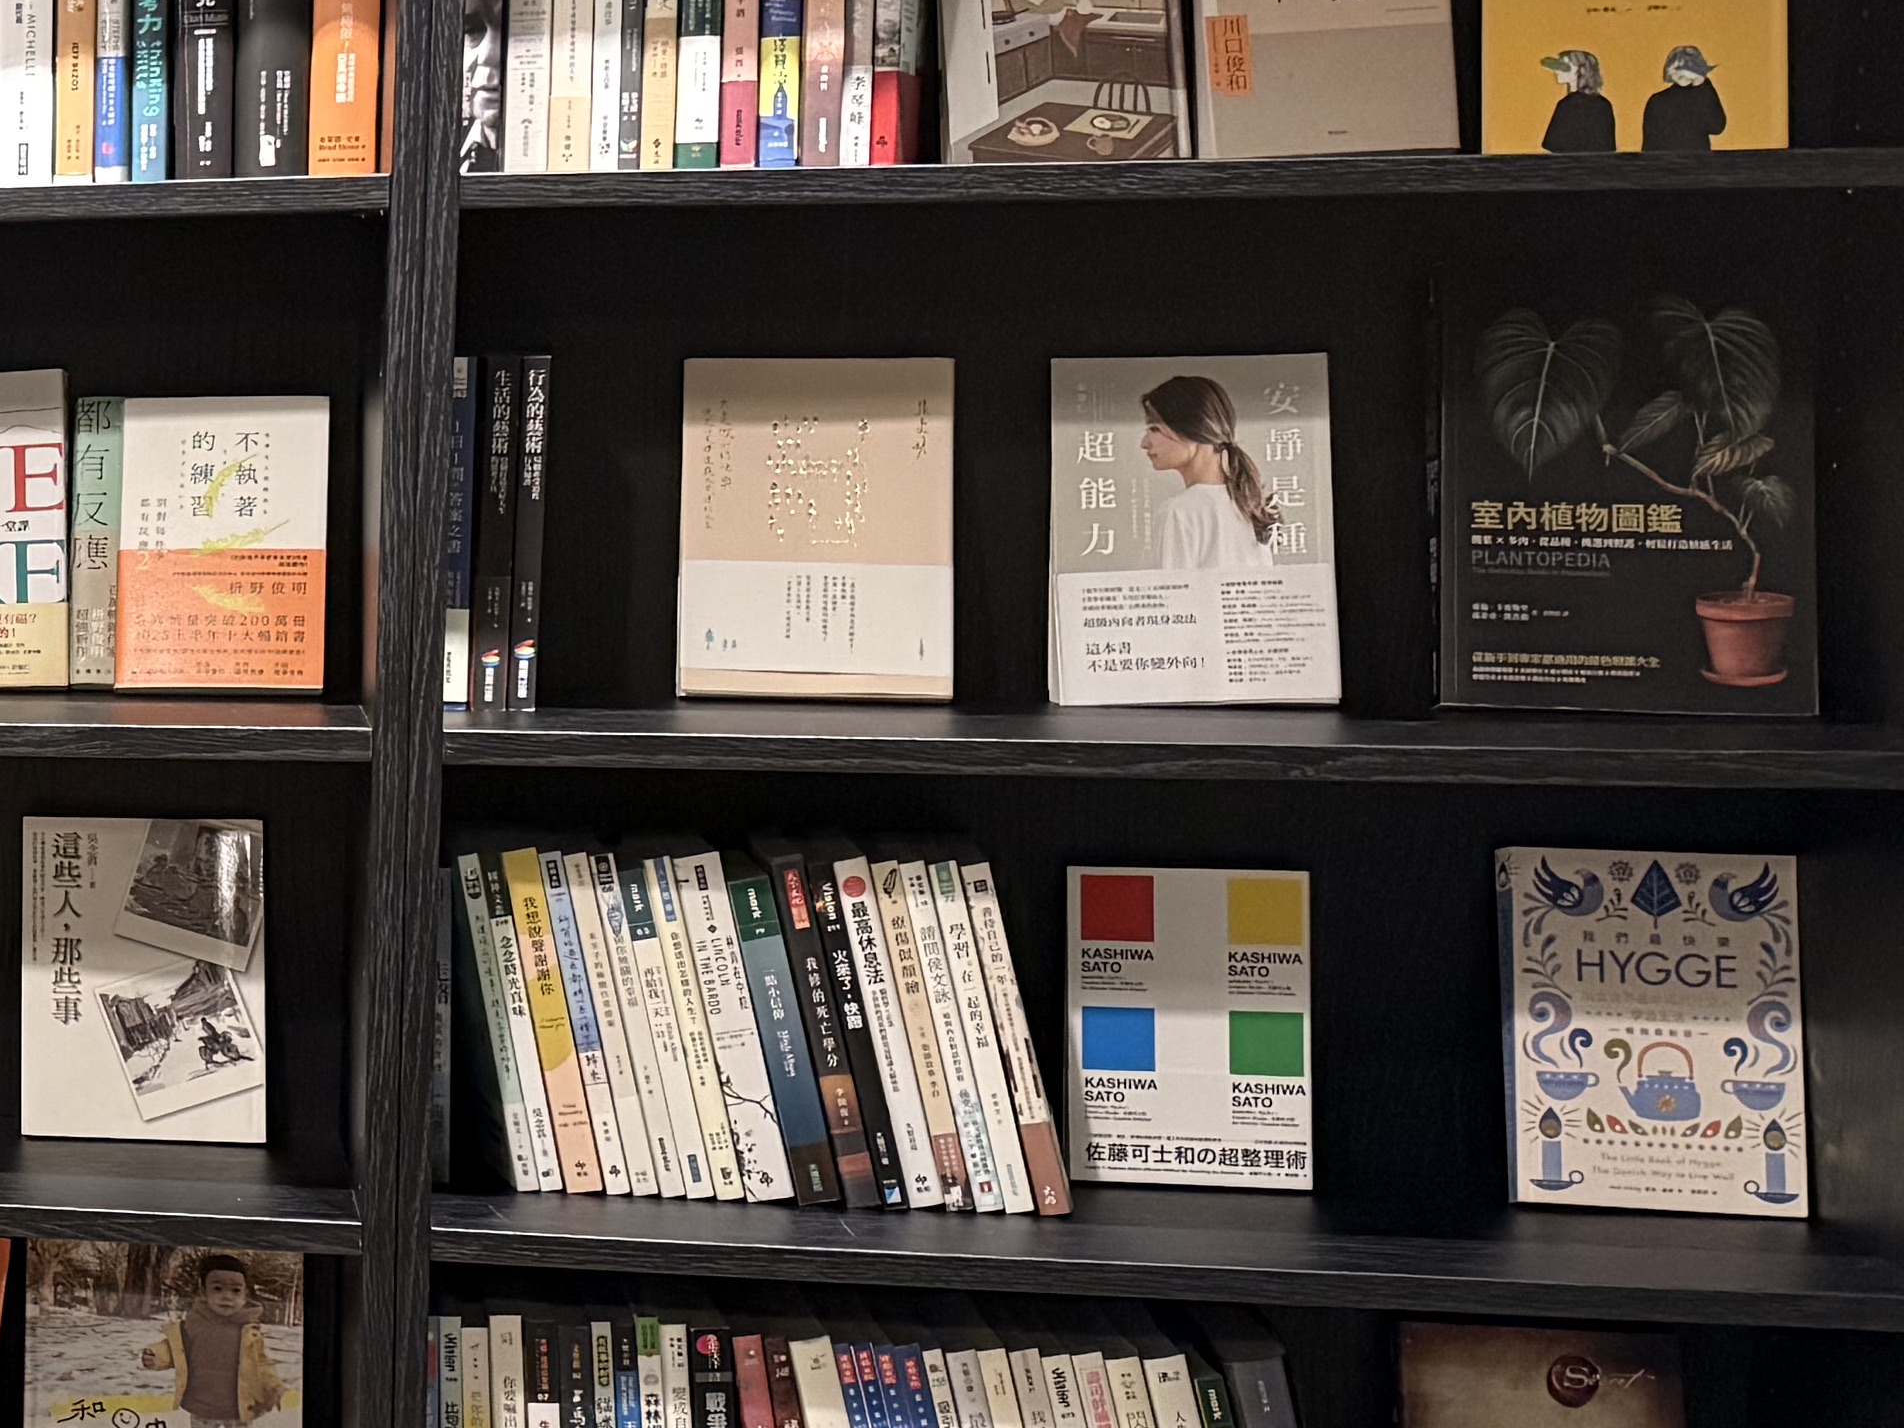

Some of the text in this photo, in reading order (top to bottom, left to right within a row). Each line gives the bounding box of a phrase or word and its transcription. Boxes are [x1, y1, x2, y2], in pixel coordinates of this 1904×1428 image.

[1223, 16, 1249, 93] 川口俊和
[491, 369, 512, 454] 生活的藝術
[189, 431, 216, 518] 的練習
[234, 431, 260, 518] 不執著
[1264, 382, 1308, 555] 安靜是種
[74, 400, 112, 571] 都有反應
[1077, 430, 1117, 557] 超能力
[1470, 500, 1683, 534] 室內植物圖鑑
[1471, 550, 1611, 570] PLANTOPEDIA
[1085, 641, 1131, 656] 這本書
[1087, 656, 1205, 673] 不是要你變外向！
[52, 831, 83, 1026] 這些人，那些事
[850, 901, 885, 986] 最高休息法
[1081, 948, 1154, 961] KASHIWA
[1081, 962, 1122, 973] SATO
[1228, 952, 1303, 965] KASHIWA
[1576, 948, 1737, 989] HYGGE
[1228, 966, 1270, 978] SATO
[1084, 1091, 1125, 1103] SATO
[1085, 1077, 1158, 1091] KASHIWA
[1232, 1083, 1306, 1096] KASHIWA
[1232, 1096, 1273, 1108] SATO
[1085, 1142, 1307, 1170] 佐藤可士和の超整理術
[57, 1399, 106, 1423] 和
